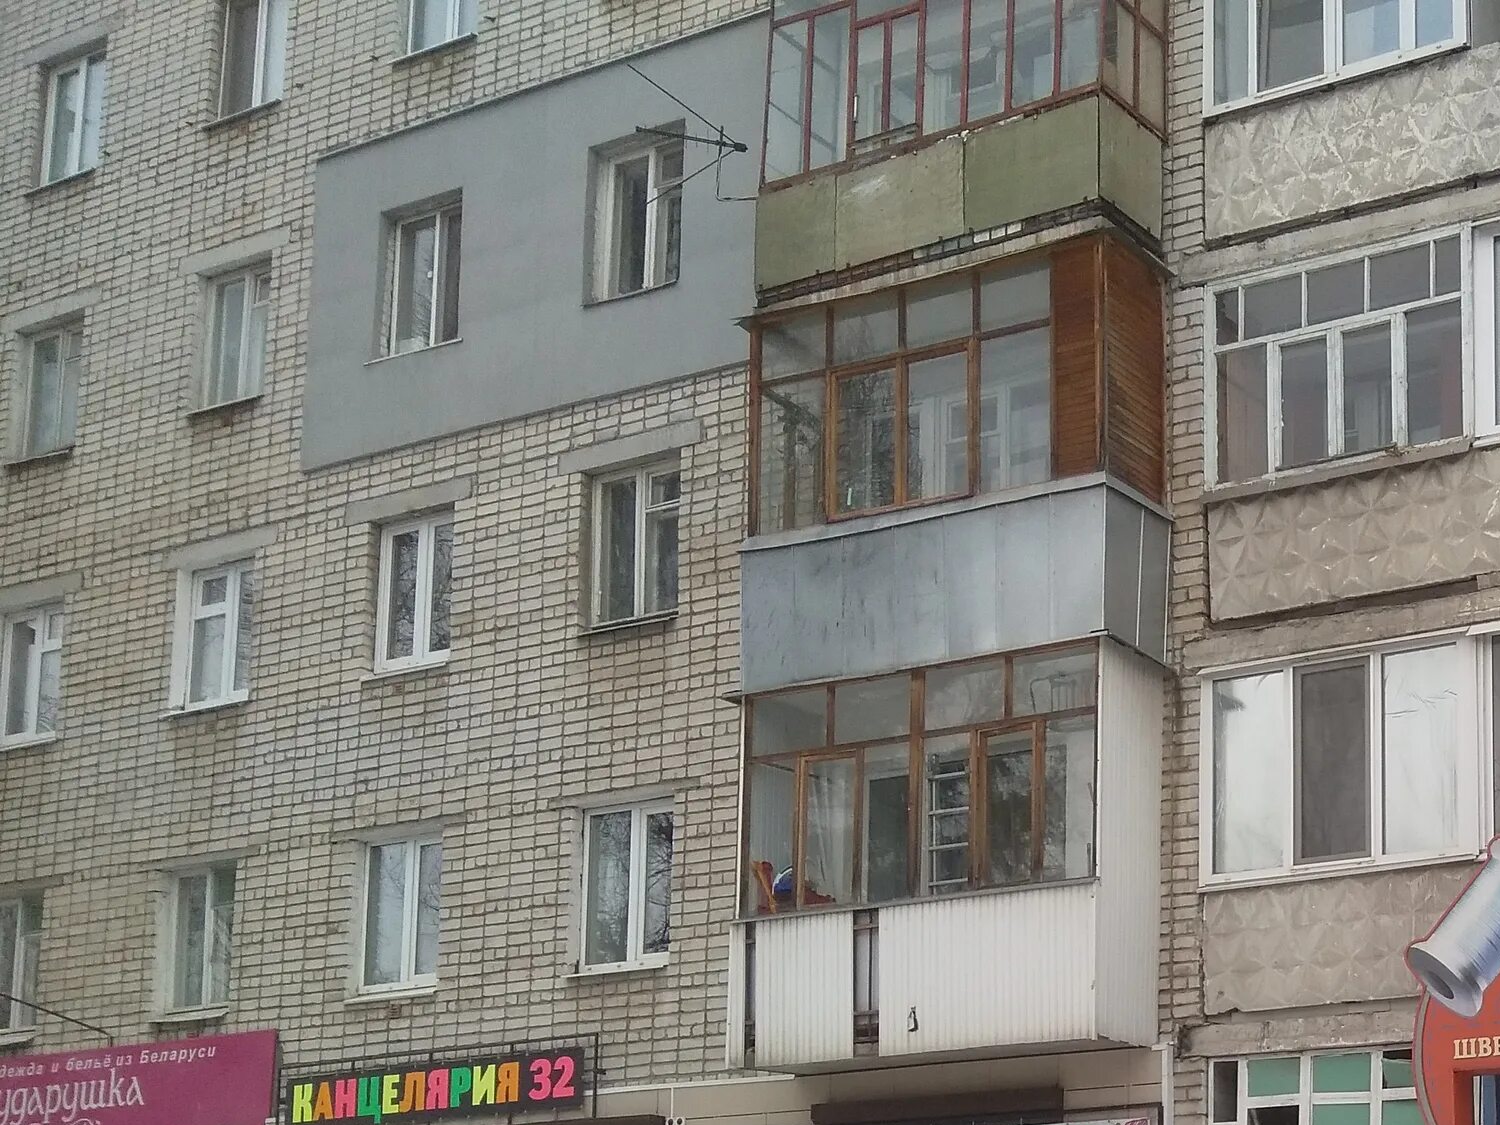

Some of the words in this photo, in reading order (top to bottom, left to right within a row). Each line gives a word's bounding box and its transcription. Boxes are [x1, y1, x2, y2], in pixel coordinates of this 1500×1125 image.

[116, 1056, 132, 1066] из
[139, 1045, 216, 1064] Беларуси
[292, 1061, 520, 1125] КАНЦЕЛЯРИЯ
[528, 1055, 576, 1101] 32
